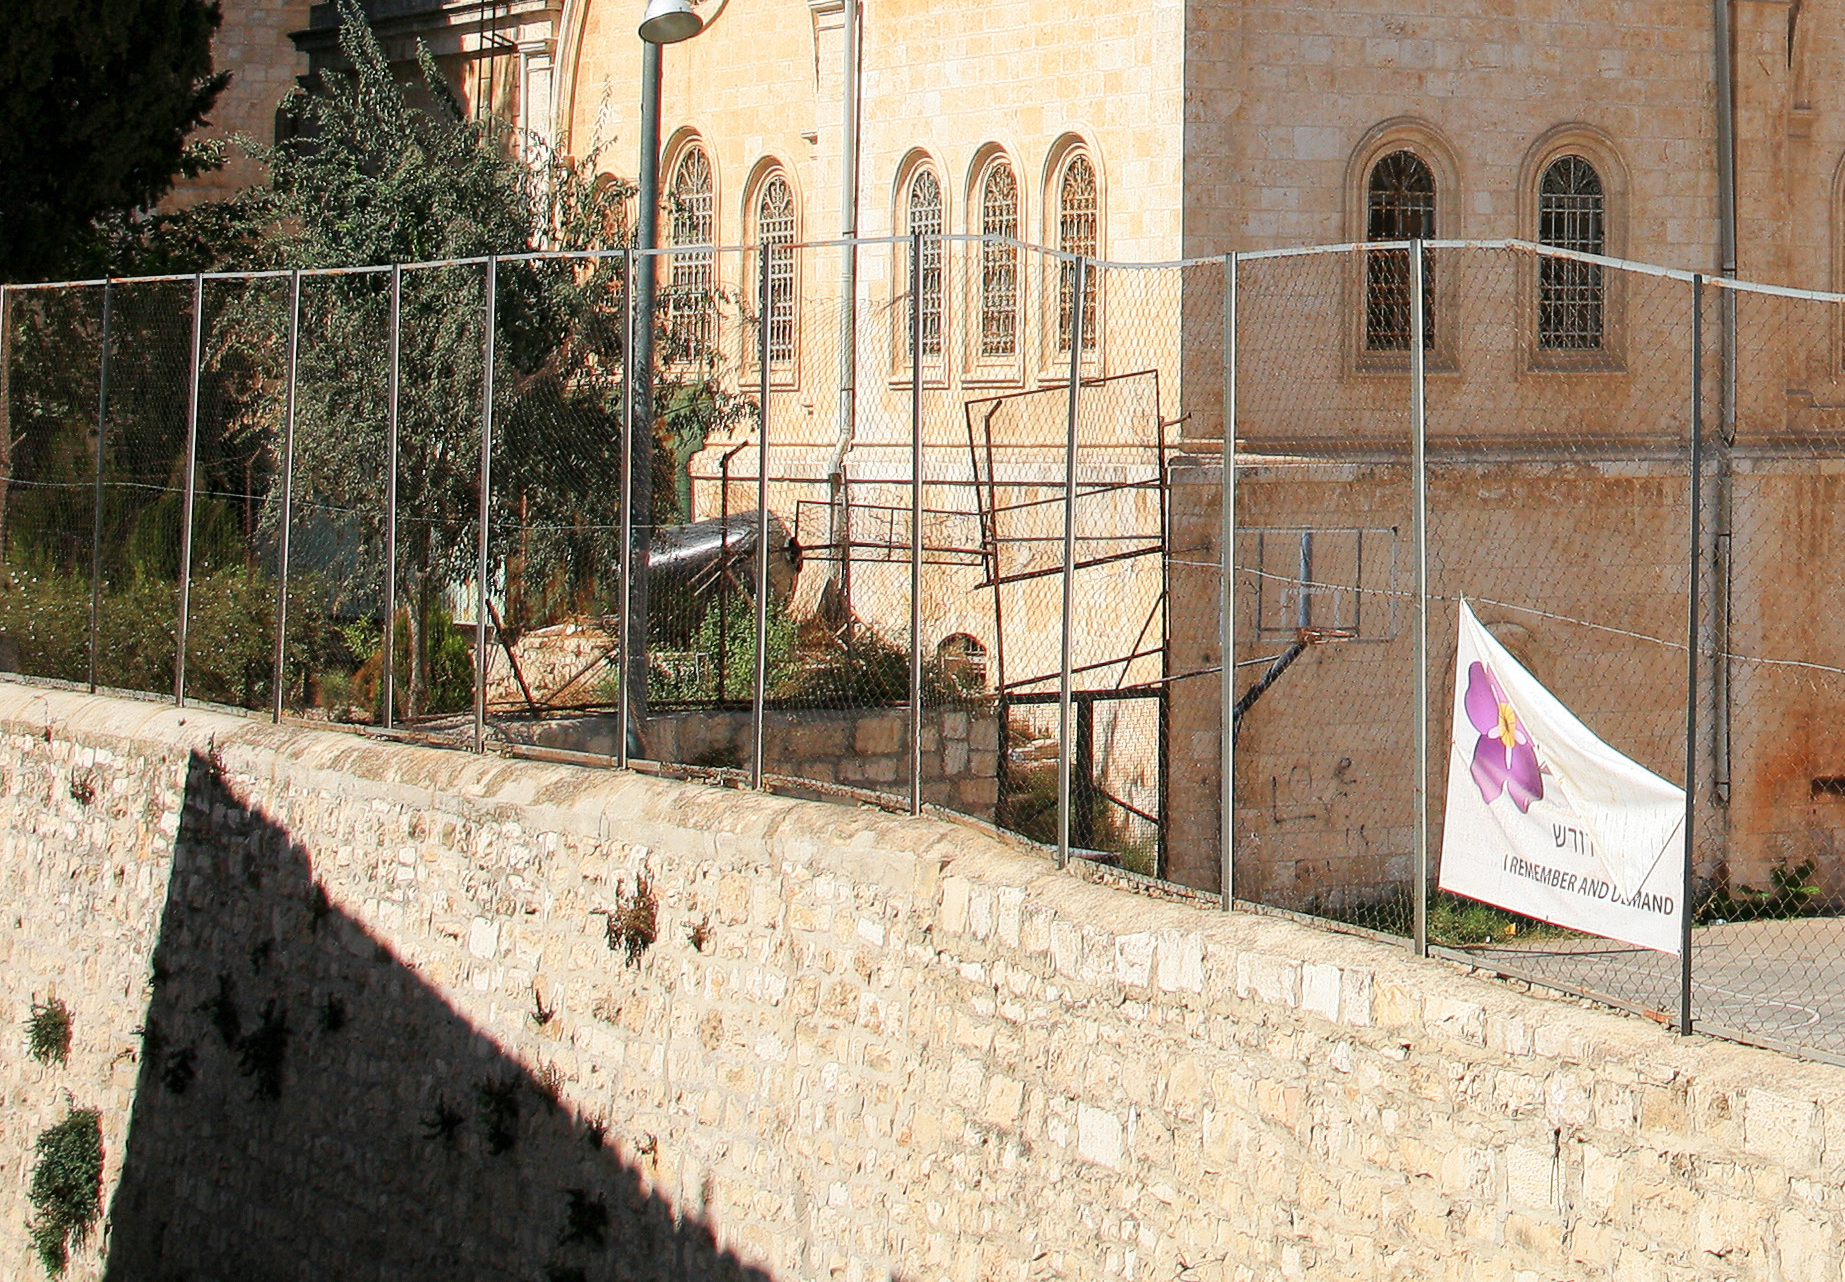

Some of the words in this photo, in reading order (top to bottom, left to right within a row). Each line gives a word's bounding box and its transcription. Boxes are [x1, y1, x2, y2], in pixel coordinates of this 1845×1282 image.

[1503, 854, 1508, 871] I
[1510, 856, 1577, 892] REMEMBER
[1578, 877, 1609, 899] AND
